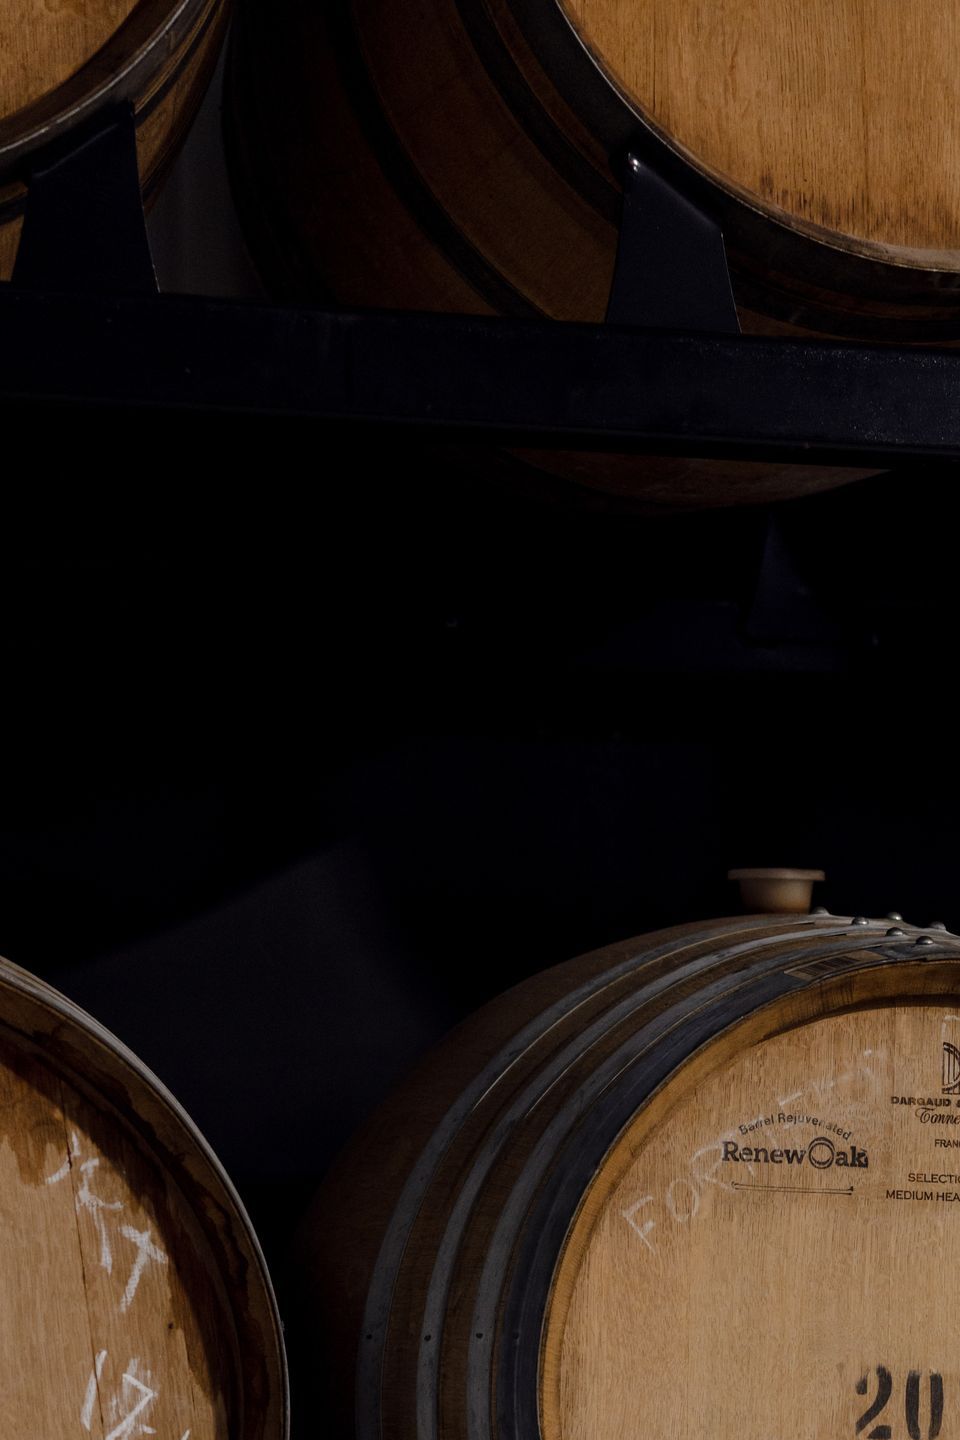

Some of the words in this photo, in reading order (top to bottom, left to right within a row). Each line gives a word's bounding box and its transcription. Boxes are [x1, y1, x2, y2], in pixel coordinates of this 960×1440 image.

[890, 1096, 952, 1107] DARGAUD
[738, 1114, 775, 1136] Barrel
[777, 1112, 852, 1141] Rejuvenated
[721, 1136, 869, 1169] RenewOak
[886, 1190, 933, 1201] MEDIUM
